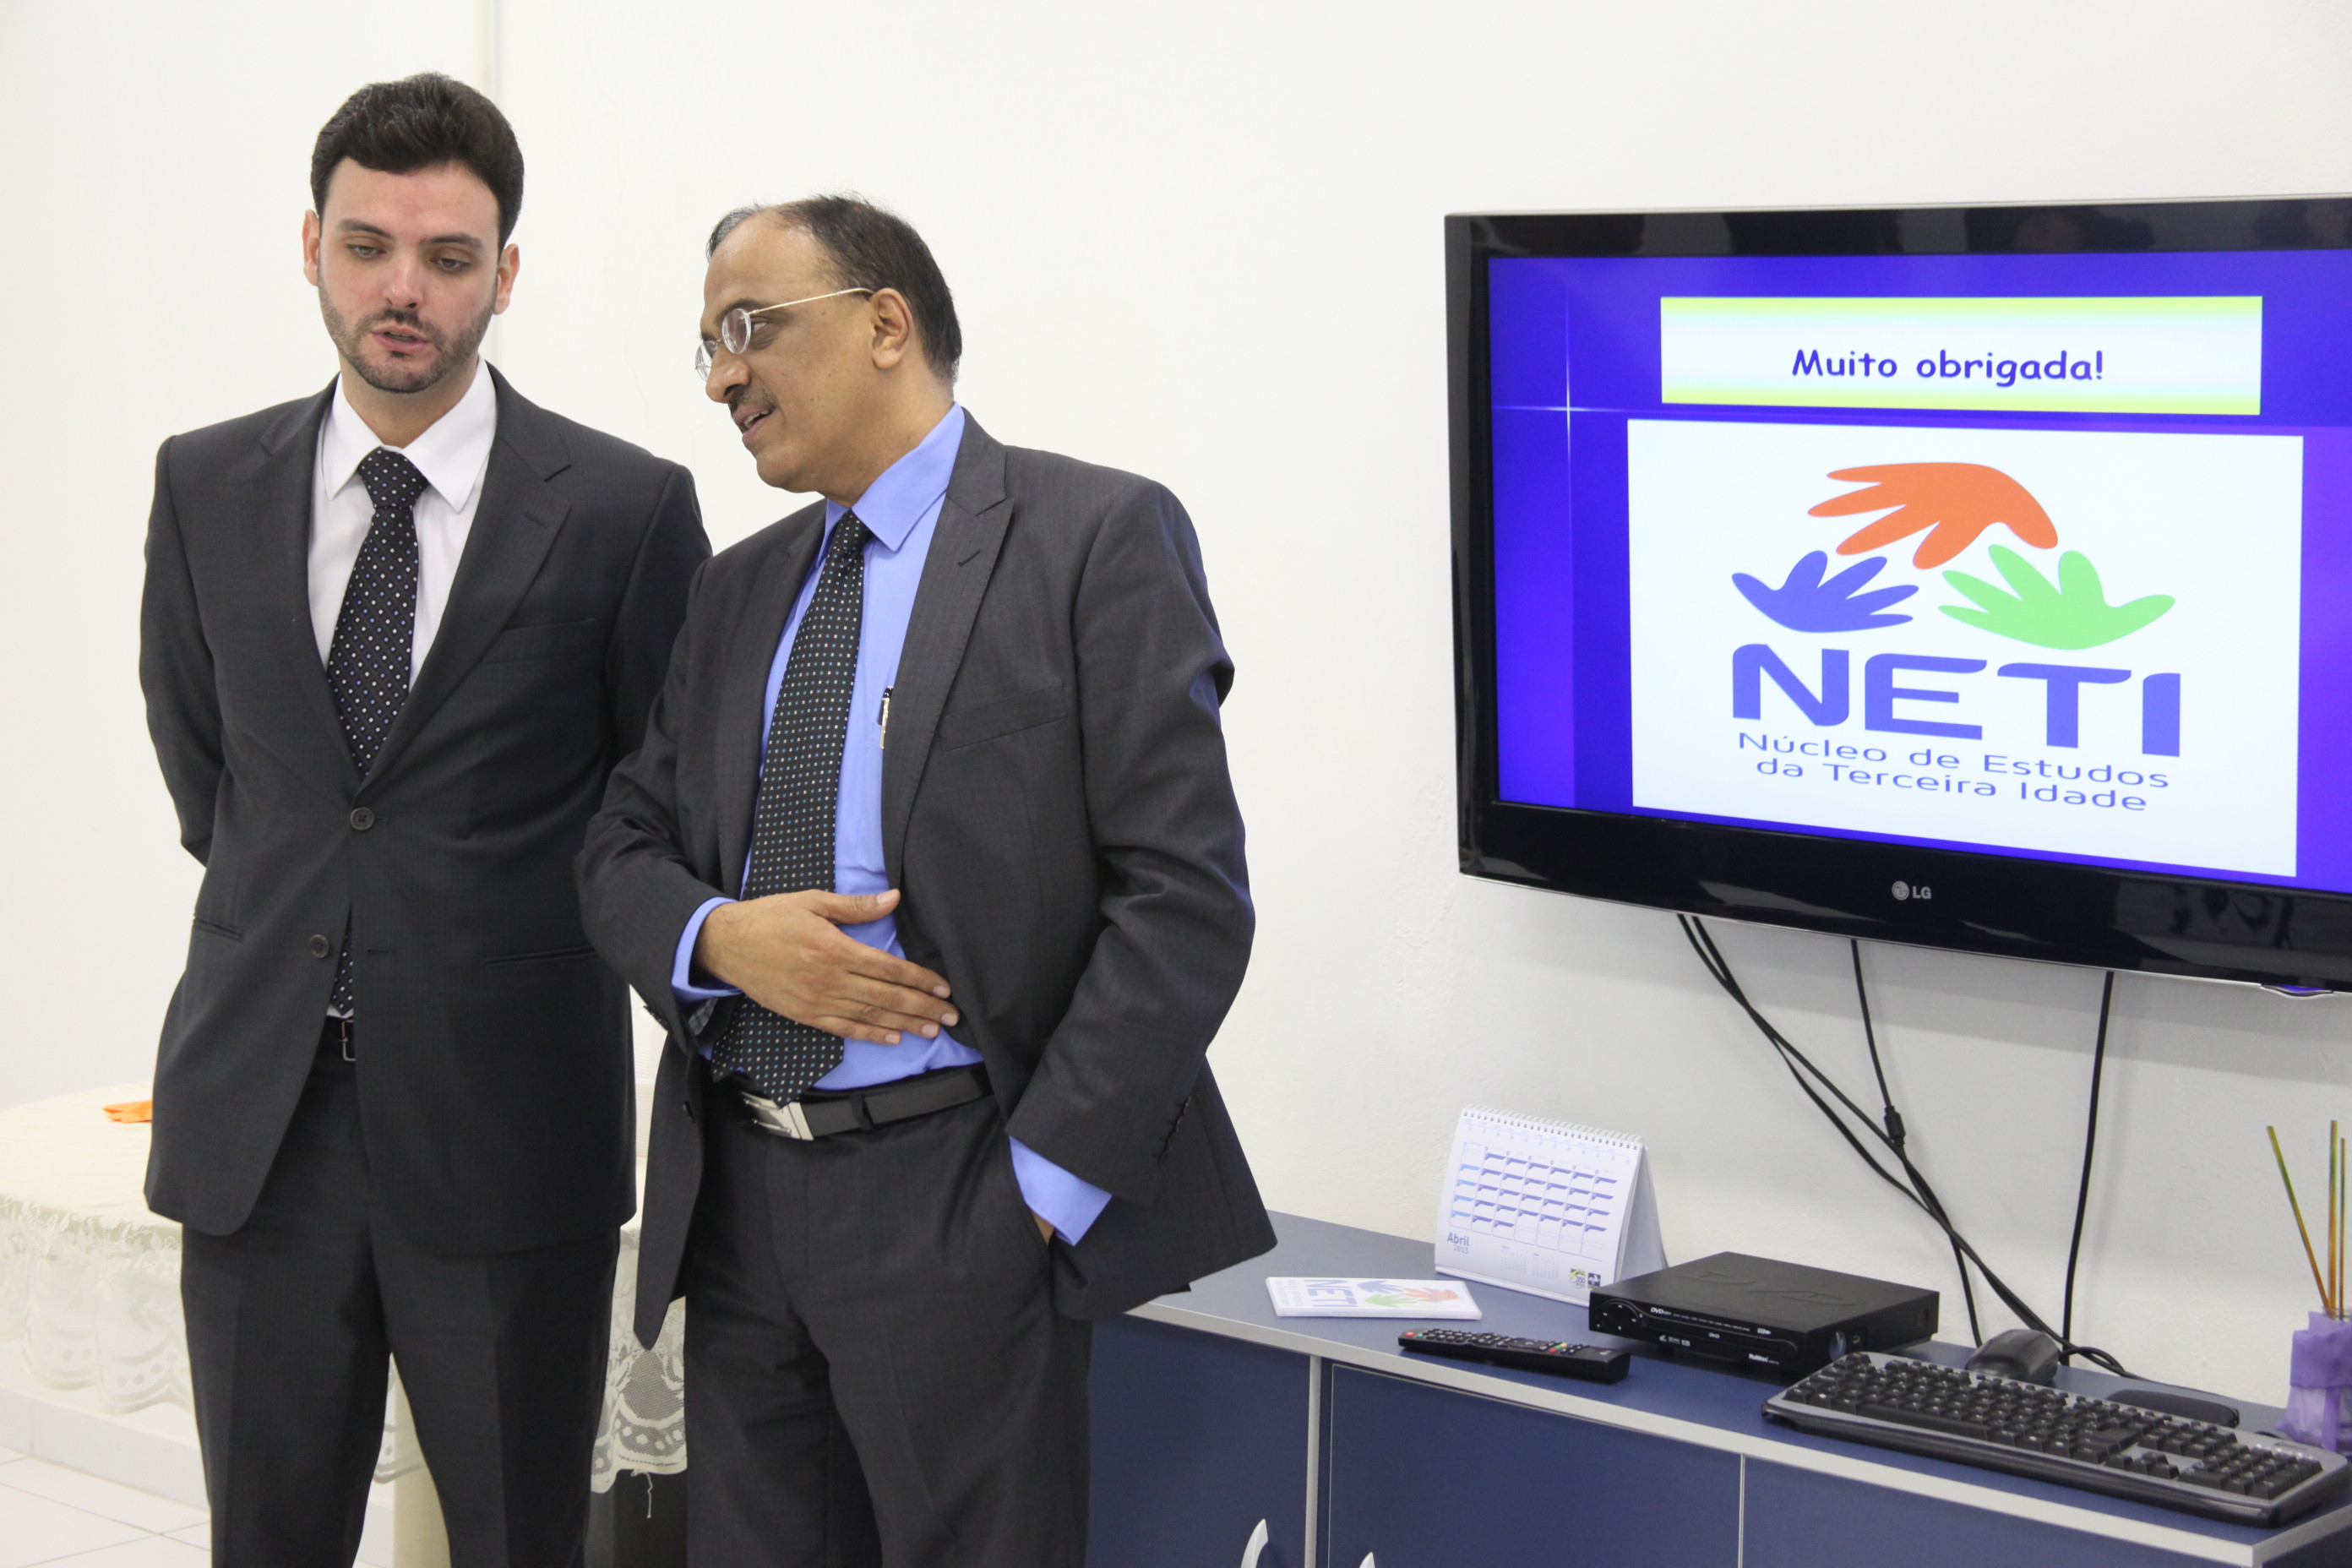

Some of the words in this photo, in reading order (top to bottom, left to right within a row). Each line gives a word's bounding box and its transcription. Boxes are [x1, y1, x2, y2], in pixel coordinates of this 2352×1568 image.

[1791, 348, 1898, 379] Muito
[1915, 348, 2104, 389] obrigada!
[1732, 643, 2181, 758] NETI
[1739, 732, 1888, 763] Núcleo
[1908, 749, 1960, 770] de
[1984, 754, 2170, 788] Estudos
[1756, 758, 1804, 779] da
[1823, 763, 1996, 797] Terceira
[2021, 781, 2147, 812] Idade
[1912, 885, 1931, 900] LG
[1446, 1232, 1470, 1247] Abril
[1304, 1279, 1359, 1308] NETI
